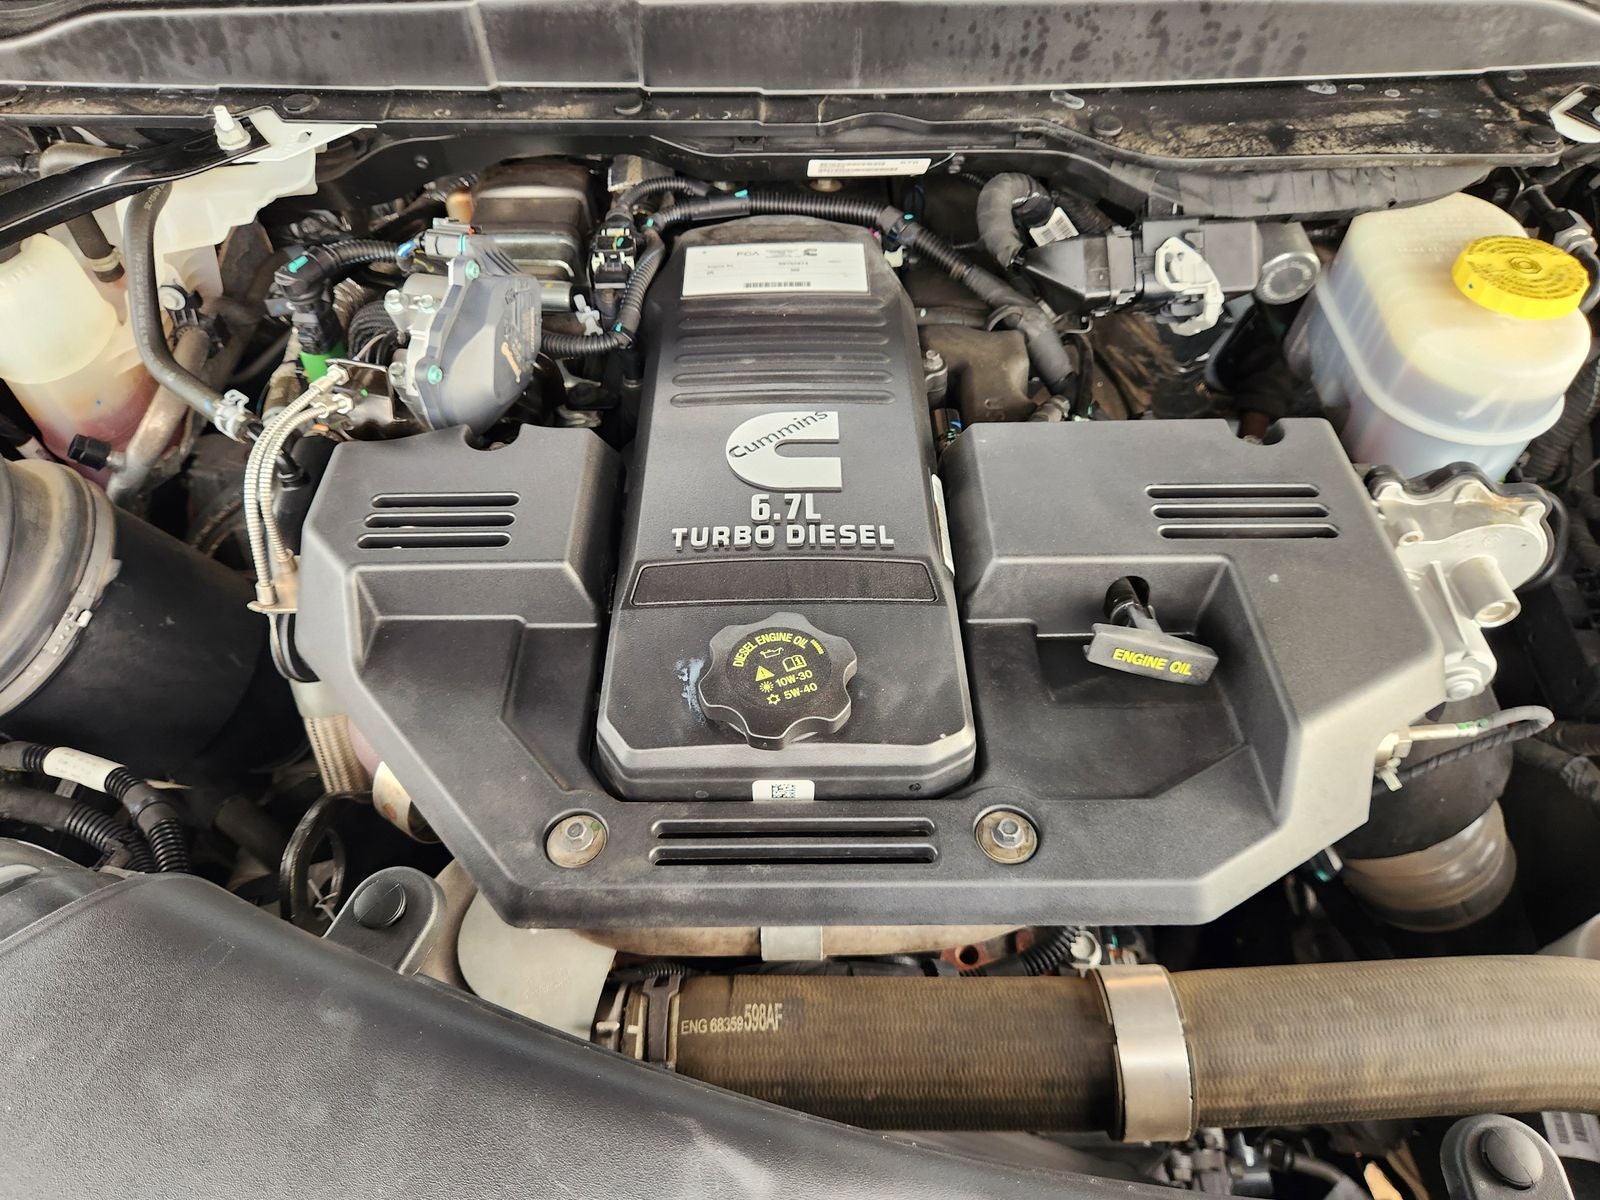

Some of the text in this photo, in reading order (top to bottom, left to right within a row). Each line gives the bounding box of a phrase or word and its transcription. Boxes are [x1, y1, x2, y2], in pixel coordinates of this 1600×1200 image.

[728, 410, 829, 458] Cummins
[751, 493, 822, 524] 6.7L
[671, 524, 895, 550] TURBO DIESEL
[732, 641, 758, 668] DIESEL
[755, 631, 793, 645] ENGINE
[793, 635, 808, 649] OIL
[1112, 648, 1192, 676] ENGINE OIL
[775, 670, 813, 688] 10W-30
[783, 682, 818, 700] 5W-40
[681, 1018, 708, 1035] ENG
